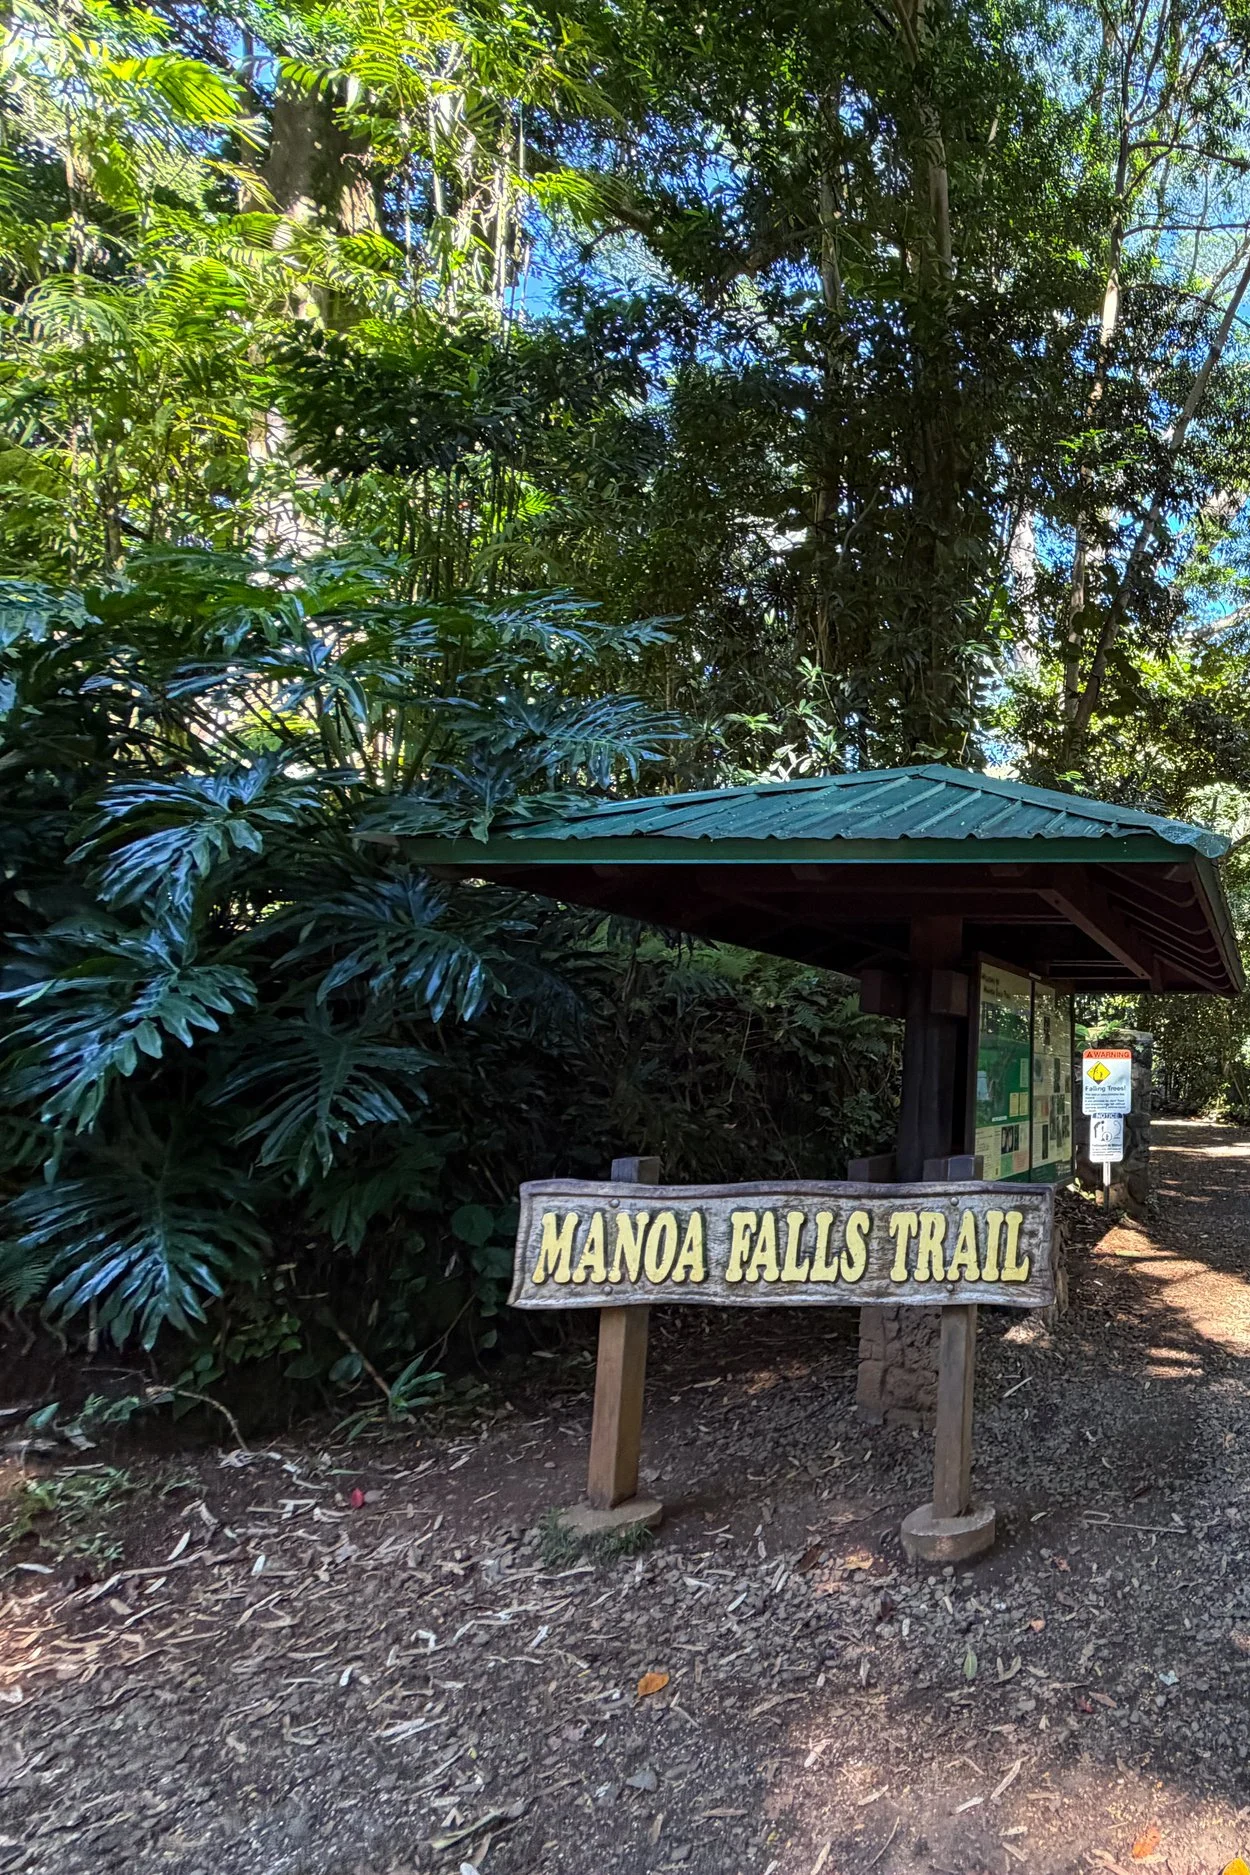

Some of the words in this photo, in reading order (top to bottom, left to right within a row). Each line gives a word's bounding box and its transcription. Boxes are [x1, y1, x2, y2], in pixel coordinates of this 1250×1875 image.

[531, 1210, 706, 1285] MANOA
[725, 1210, 871, 1284] FALLS
[888, 1210, 1031, 1283] TRAIL
